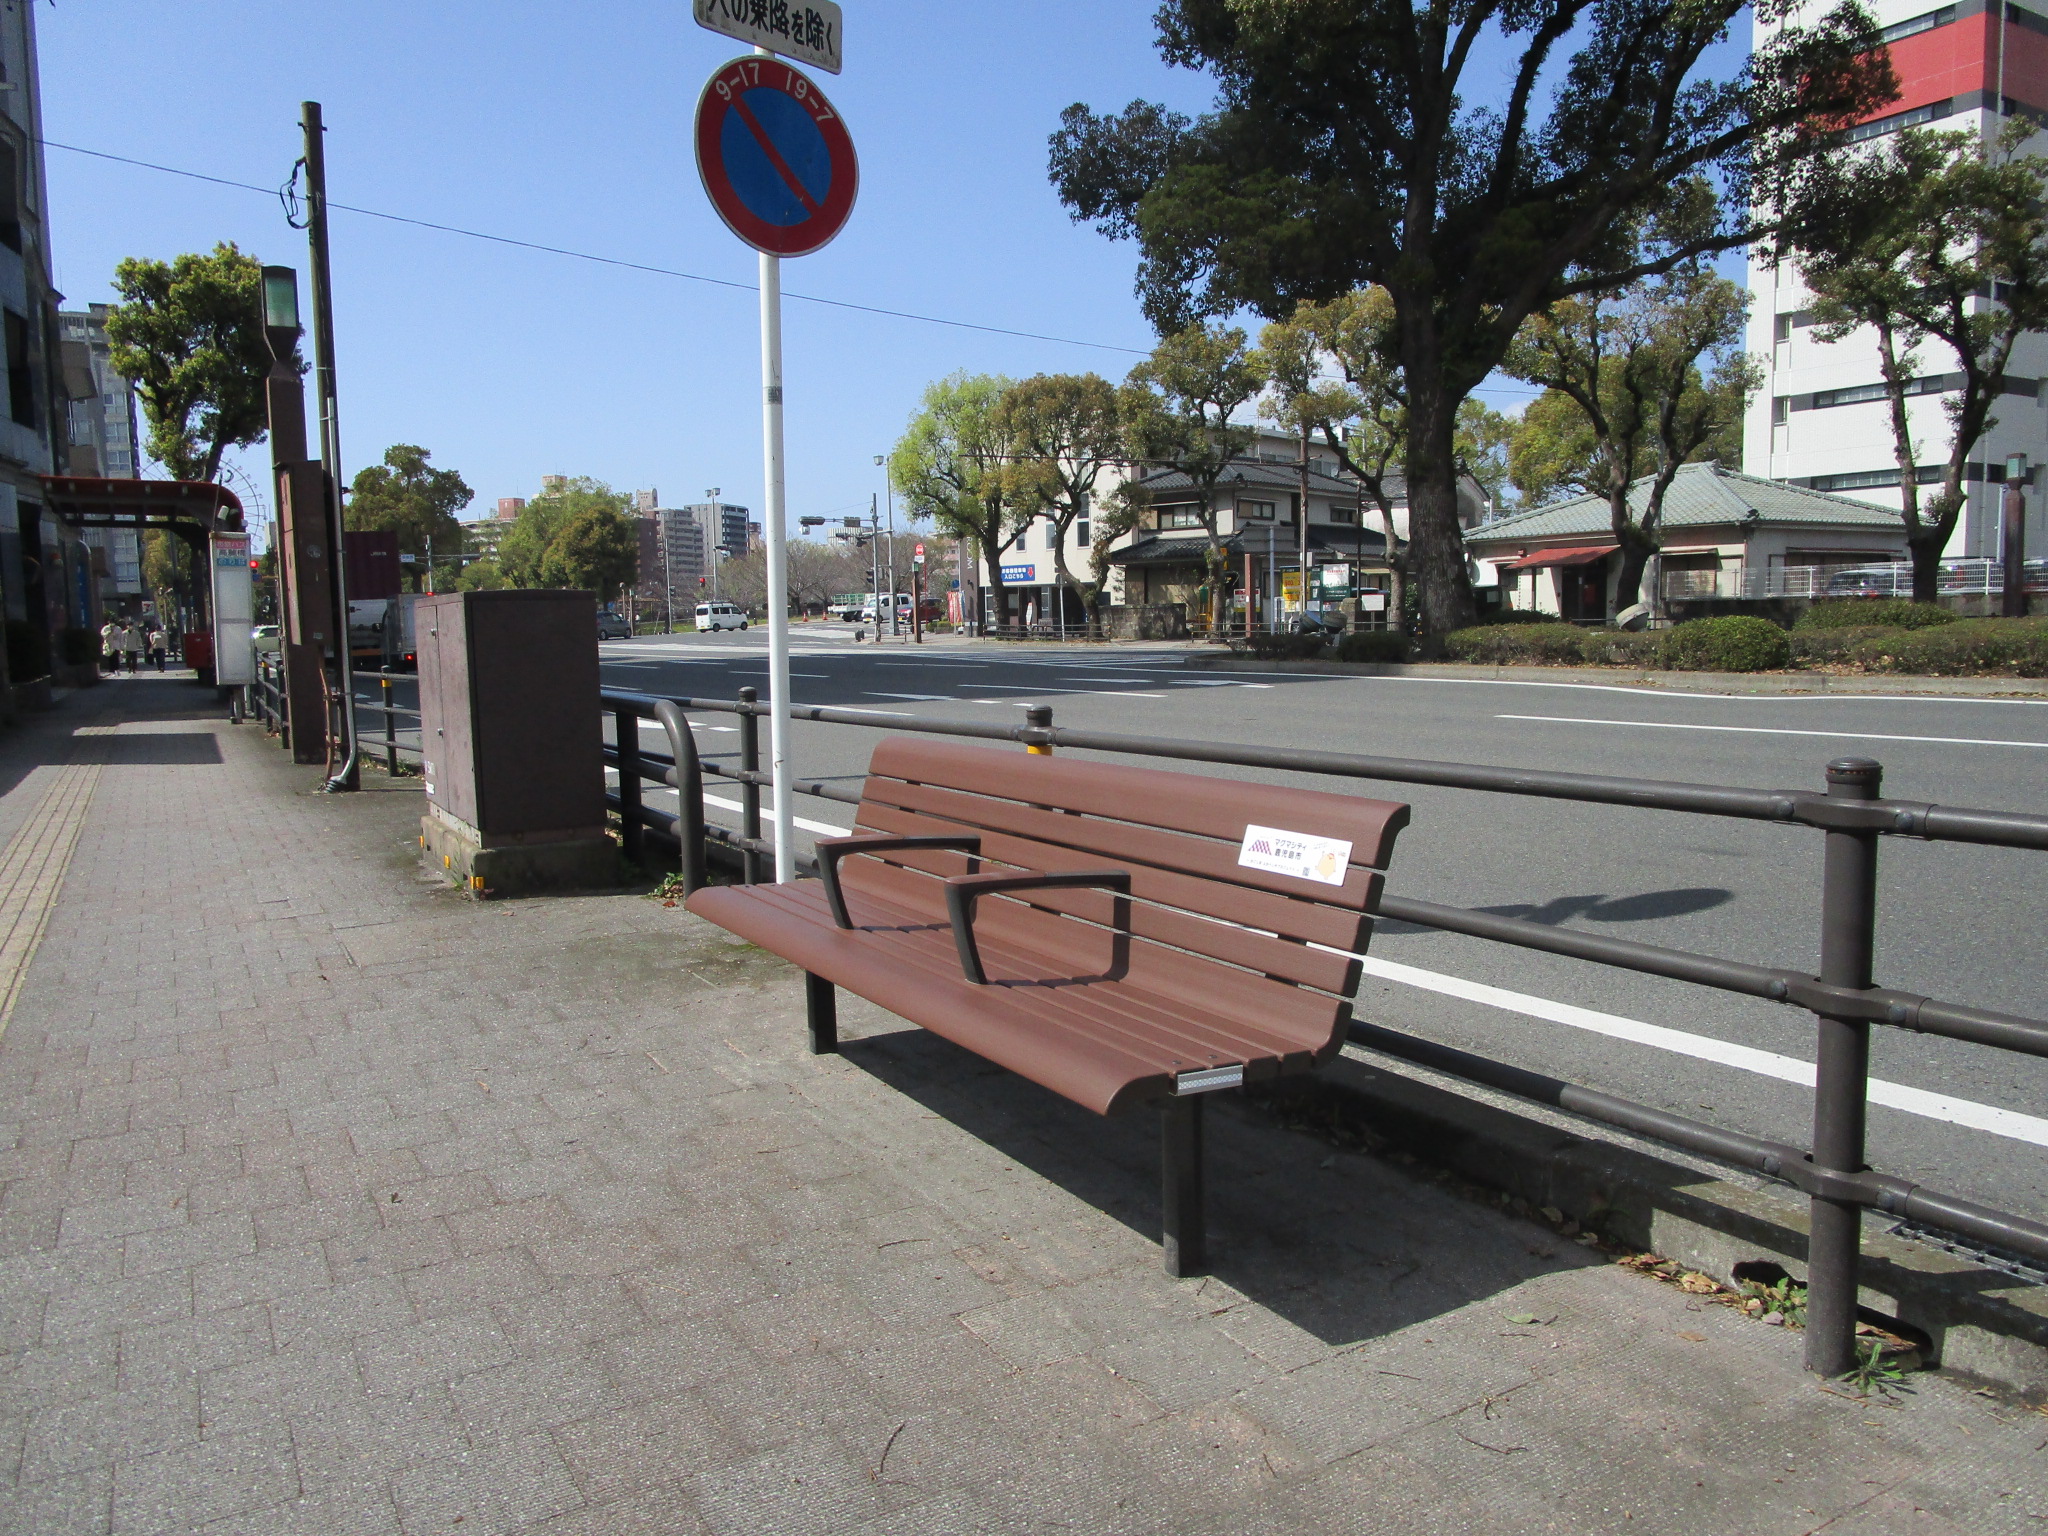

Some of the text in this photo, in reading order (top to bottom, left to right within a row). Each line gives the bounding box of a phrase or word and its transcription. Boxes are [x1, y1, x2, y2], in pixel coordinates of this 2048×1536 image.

[715, 63, 835, 121] 9-17 19-7
[1275, 838, 1307, 851] マグマシティ
